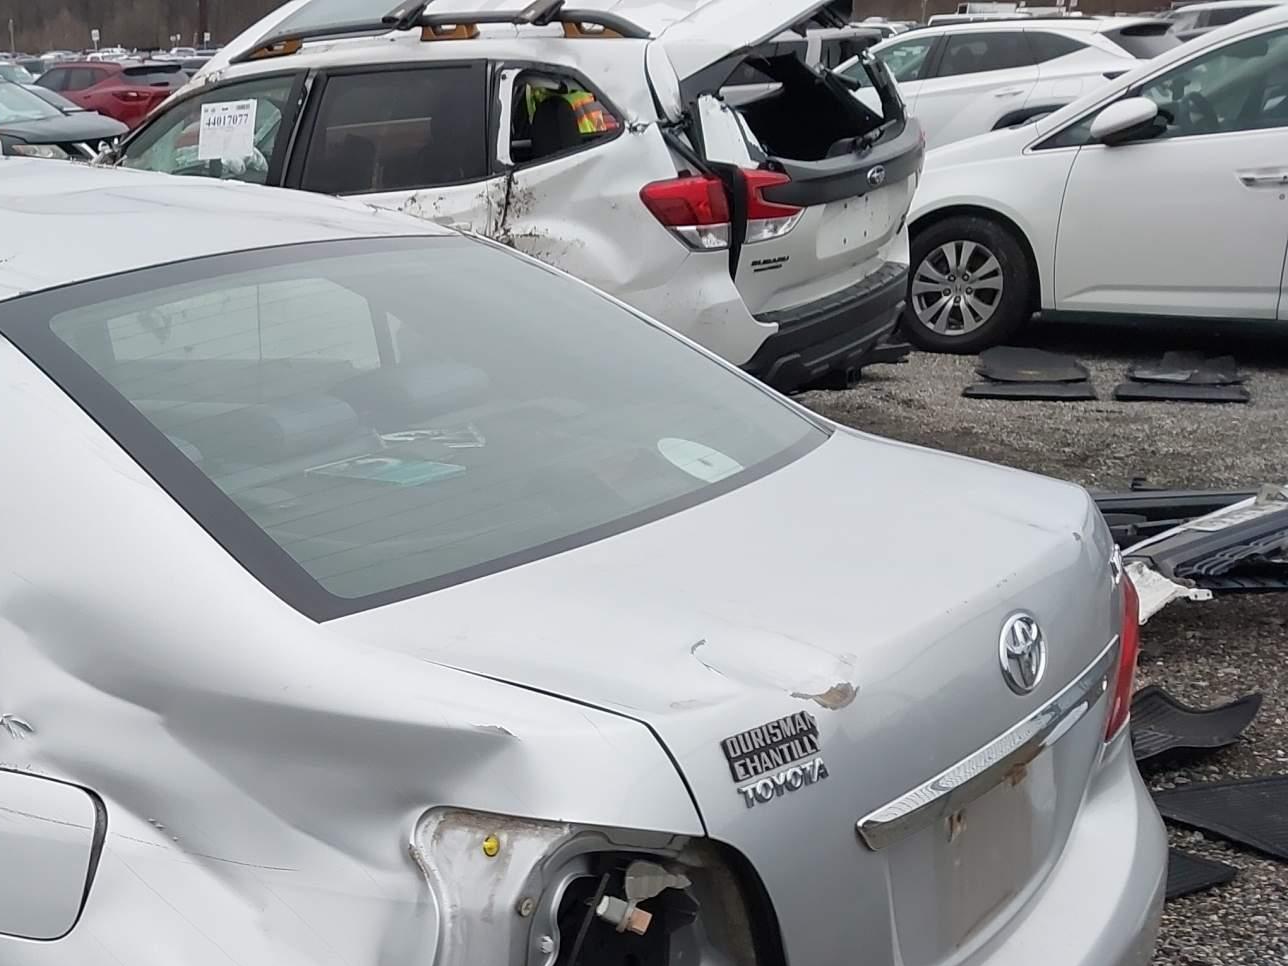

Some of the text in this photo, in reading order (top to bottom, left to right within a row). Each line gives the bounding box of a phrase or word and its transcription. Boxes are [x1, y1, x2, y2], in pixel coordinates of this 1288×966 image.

[205, 113, 249, 127] 44017077
[732, 733, 821, 781] CHANTILLY
[737, 757, 829, 809] TOYOTA
